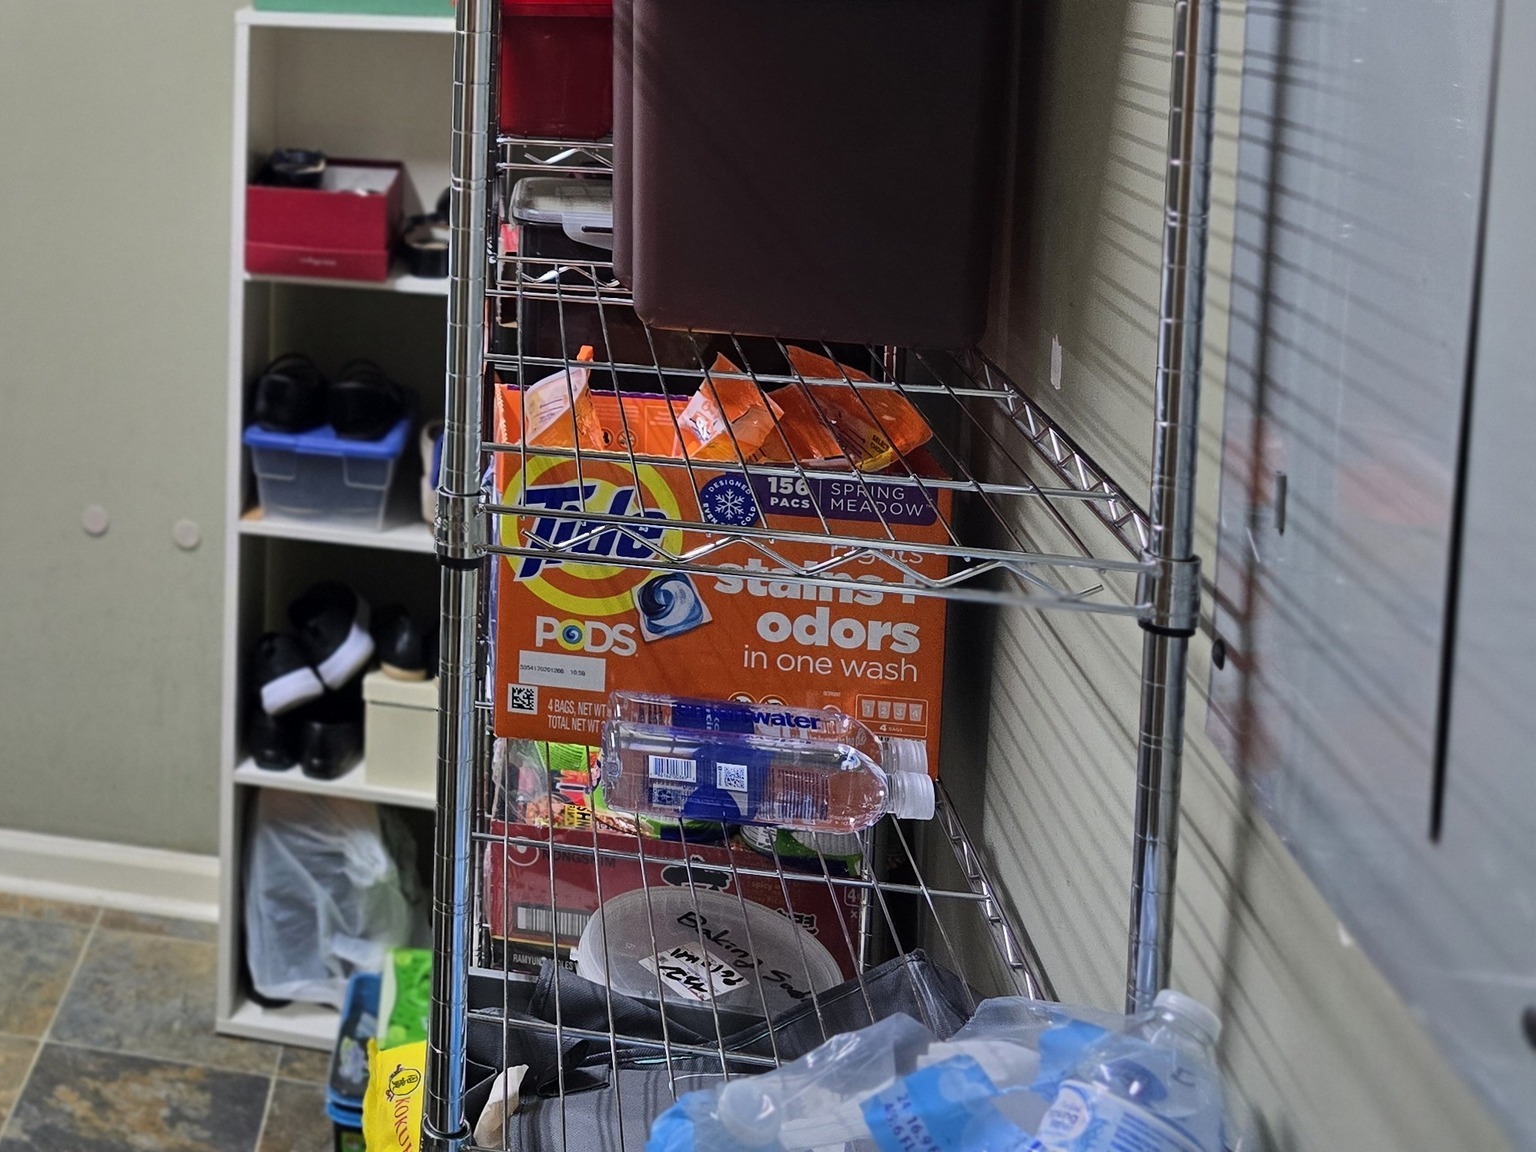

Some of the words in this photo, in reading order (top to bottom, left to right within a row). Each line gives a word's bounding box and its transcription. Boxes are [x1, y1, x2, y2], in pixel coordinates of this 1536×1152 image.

[708, 479, 752, 496] DESIGNED
[768, 476, 811, 495] 156
[830, 482, 905, 500] SPRING
[770, 497, 811, 509] PACS
[740, 506, 757, 527] COLD
[714, 558, 884, 606] stains
[535, 615, 637, 657] PODS
[756, 606, 921, 654] odors
[743, 644, 768, 670] in
[776, 653, 833, 675] one
[840, 657, 918, 682] wash
[548, 698, 554, 710] 4
[554, 699, 576, 715] BAGS,
[577, 702, 593, 716] NET
[593, 703, 607, 717] WT
[547, 714, 571, 729] TOTAL
[571, 718, 587, 731] NET
[586, 720, 600, 733] WT
[880, 724, 887, 732] 4
